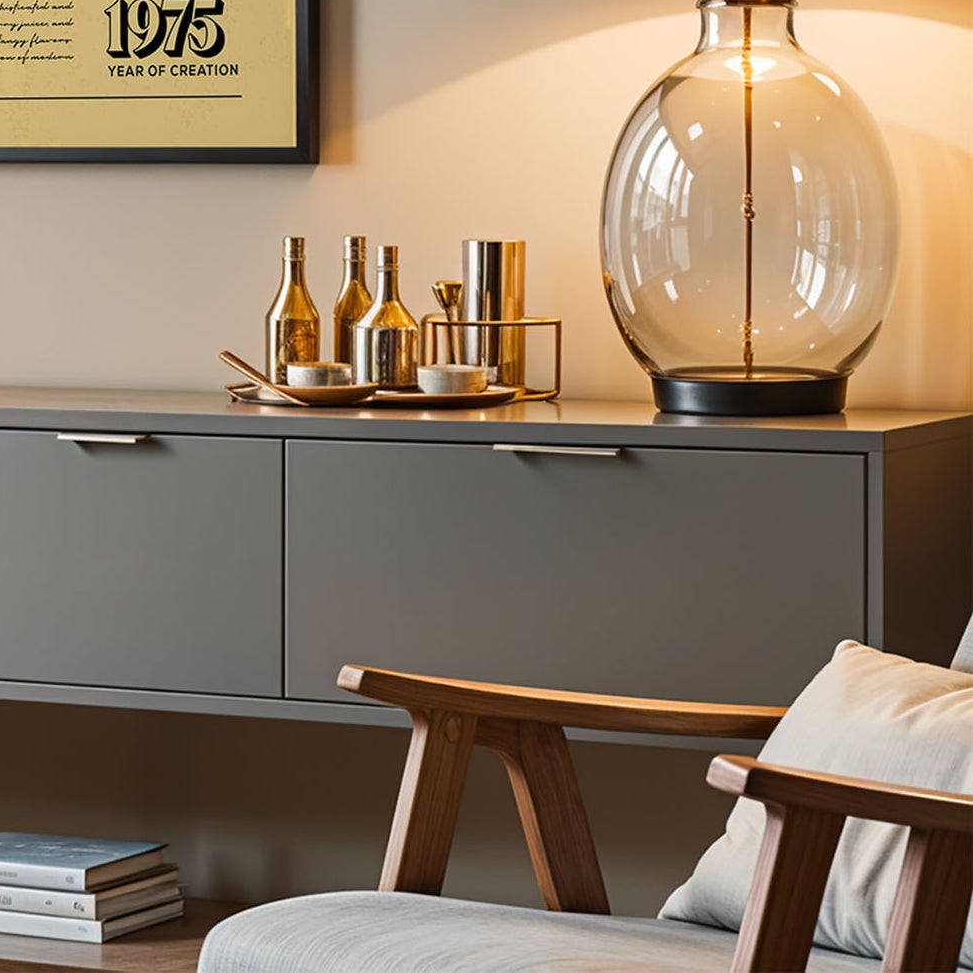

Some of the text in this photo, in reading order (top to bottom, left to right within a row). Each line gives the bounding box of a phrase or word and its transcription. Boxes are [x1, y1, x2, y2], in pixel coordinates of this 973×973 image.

[51, 1, 75, 10] and
[51, 18, 75, 27] and
[17, 49, 30, 65] of
[30, 51, 75, 60] modern
[107, 63, 239, 77] YEAR OF CREATION
